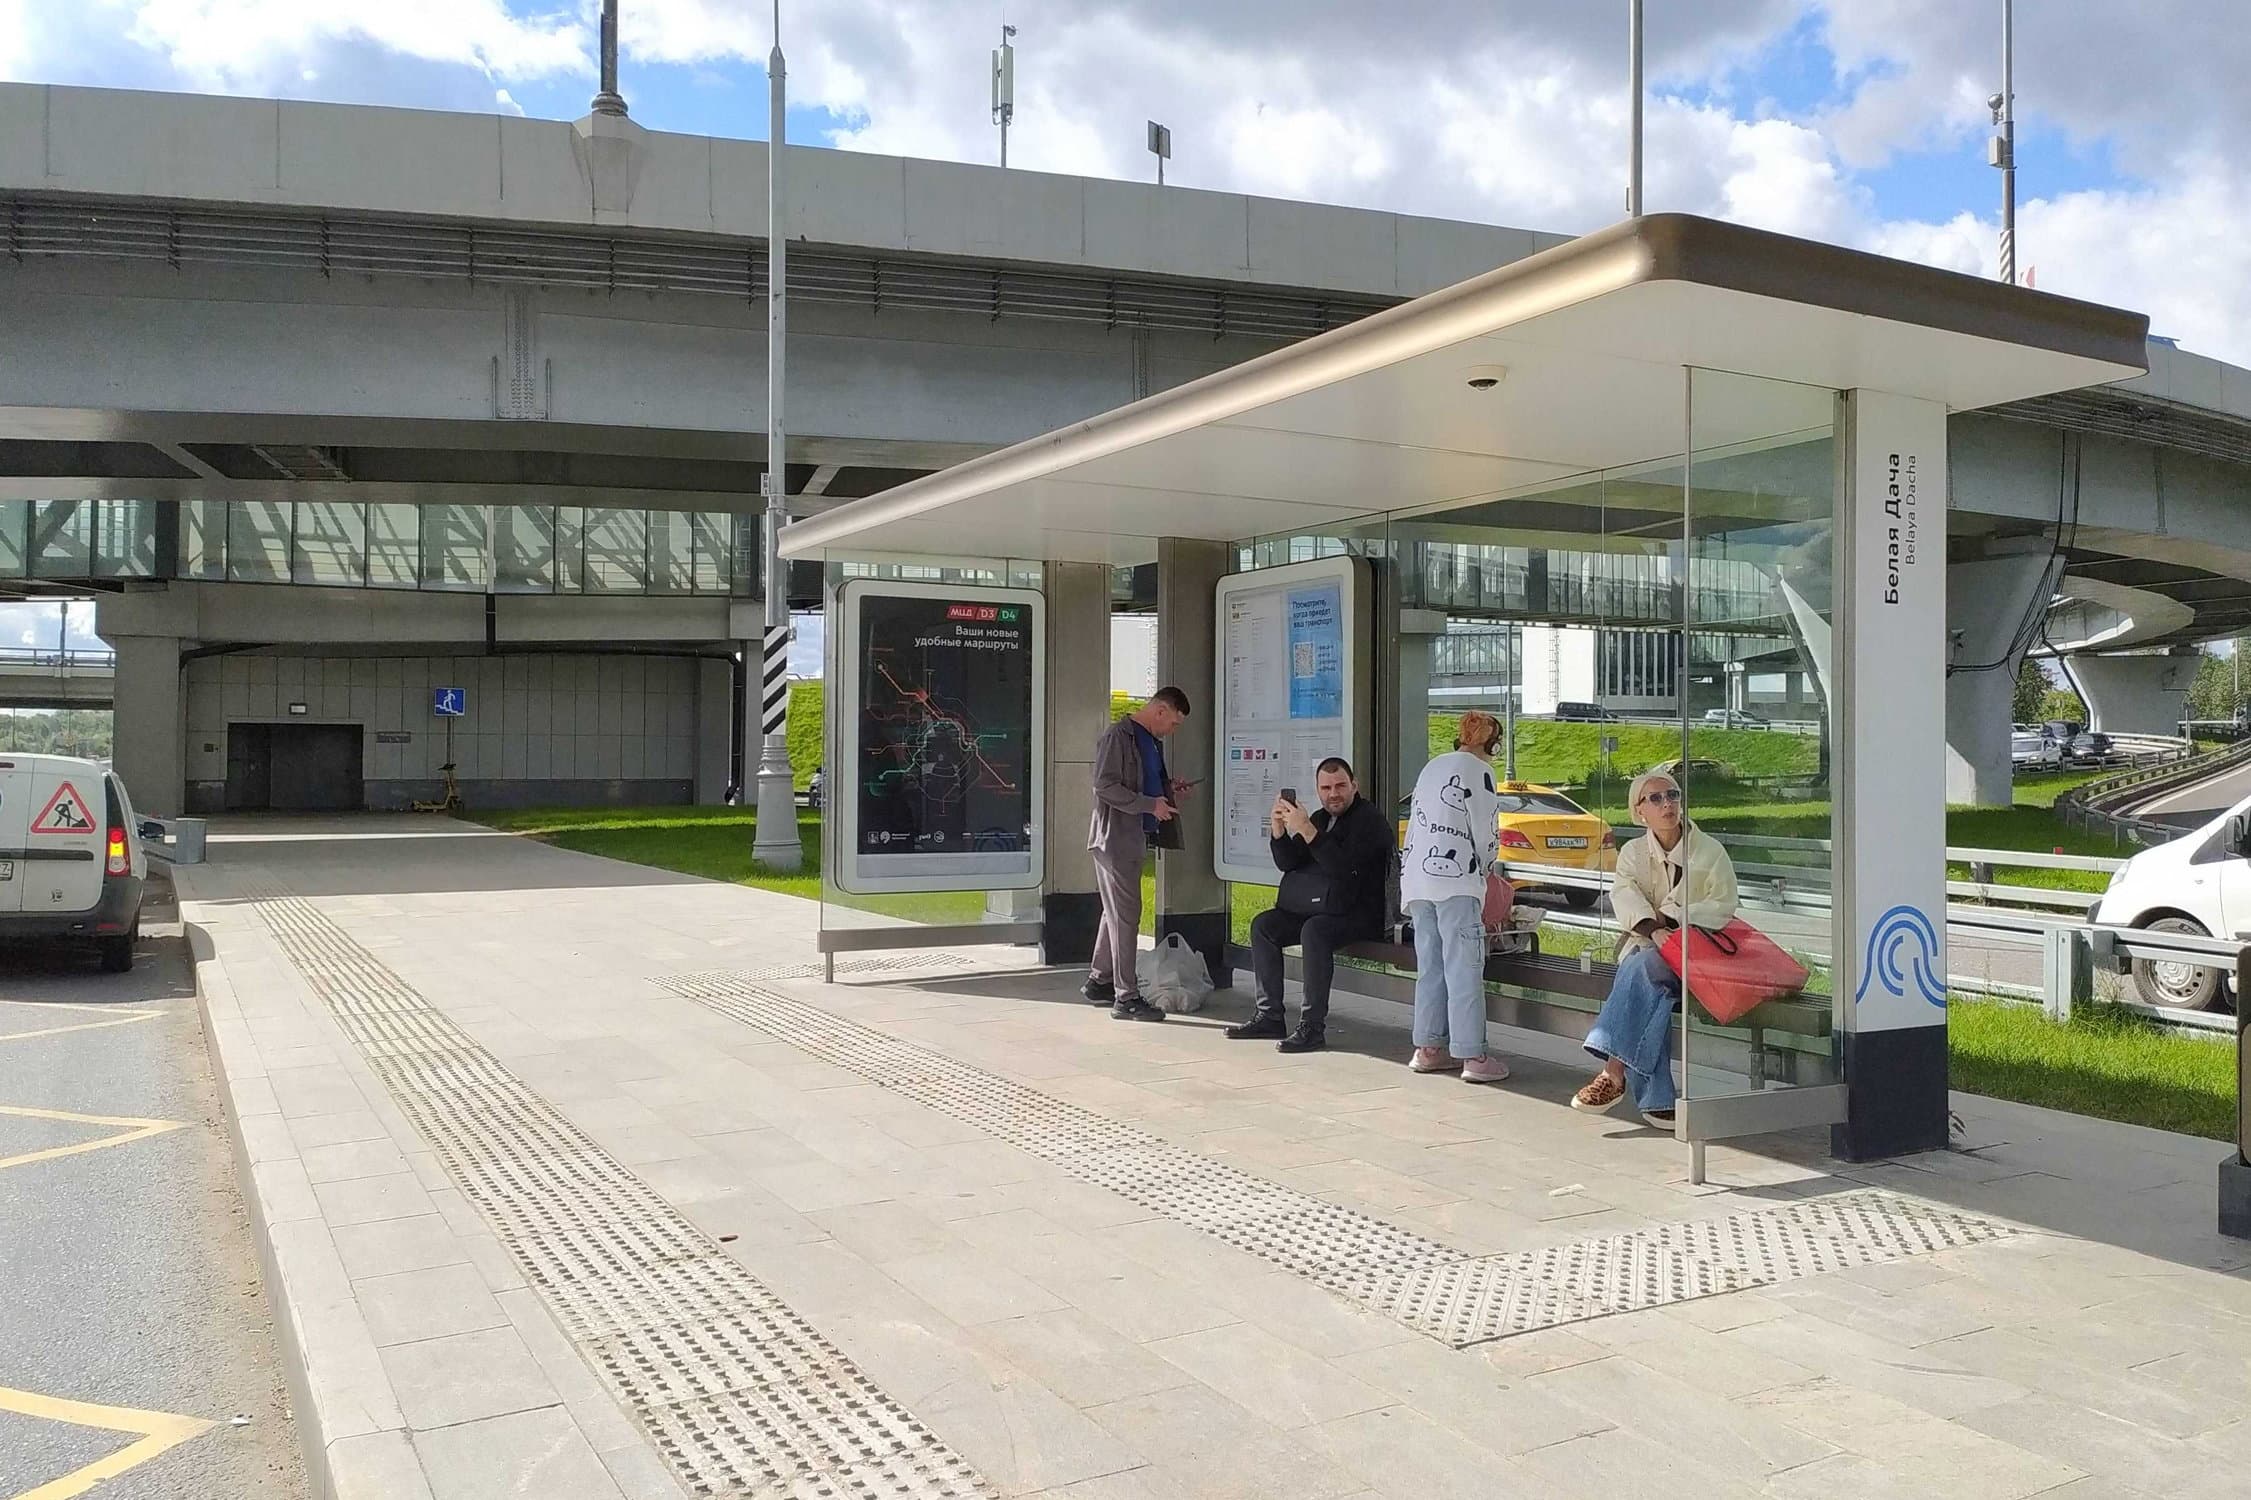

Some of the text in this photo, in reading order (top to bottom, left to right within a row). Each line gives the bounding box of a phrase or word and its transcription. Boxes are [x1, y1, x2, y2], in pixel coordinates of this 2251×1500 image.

[1905, 455, 1918, 565] Belaya Dacha
[1884, 453, 1902, 605] Белая Дача
[980, 608, 995, 618] D3
[1001, 610, 1016, 619] D4
[955, 625, 1019, 638] Ваши новые
[914, 636, 1019, 650] удобные маршруты
[1430, 823, 1471, 840] Bonjou
